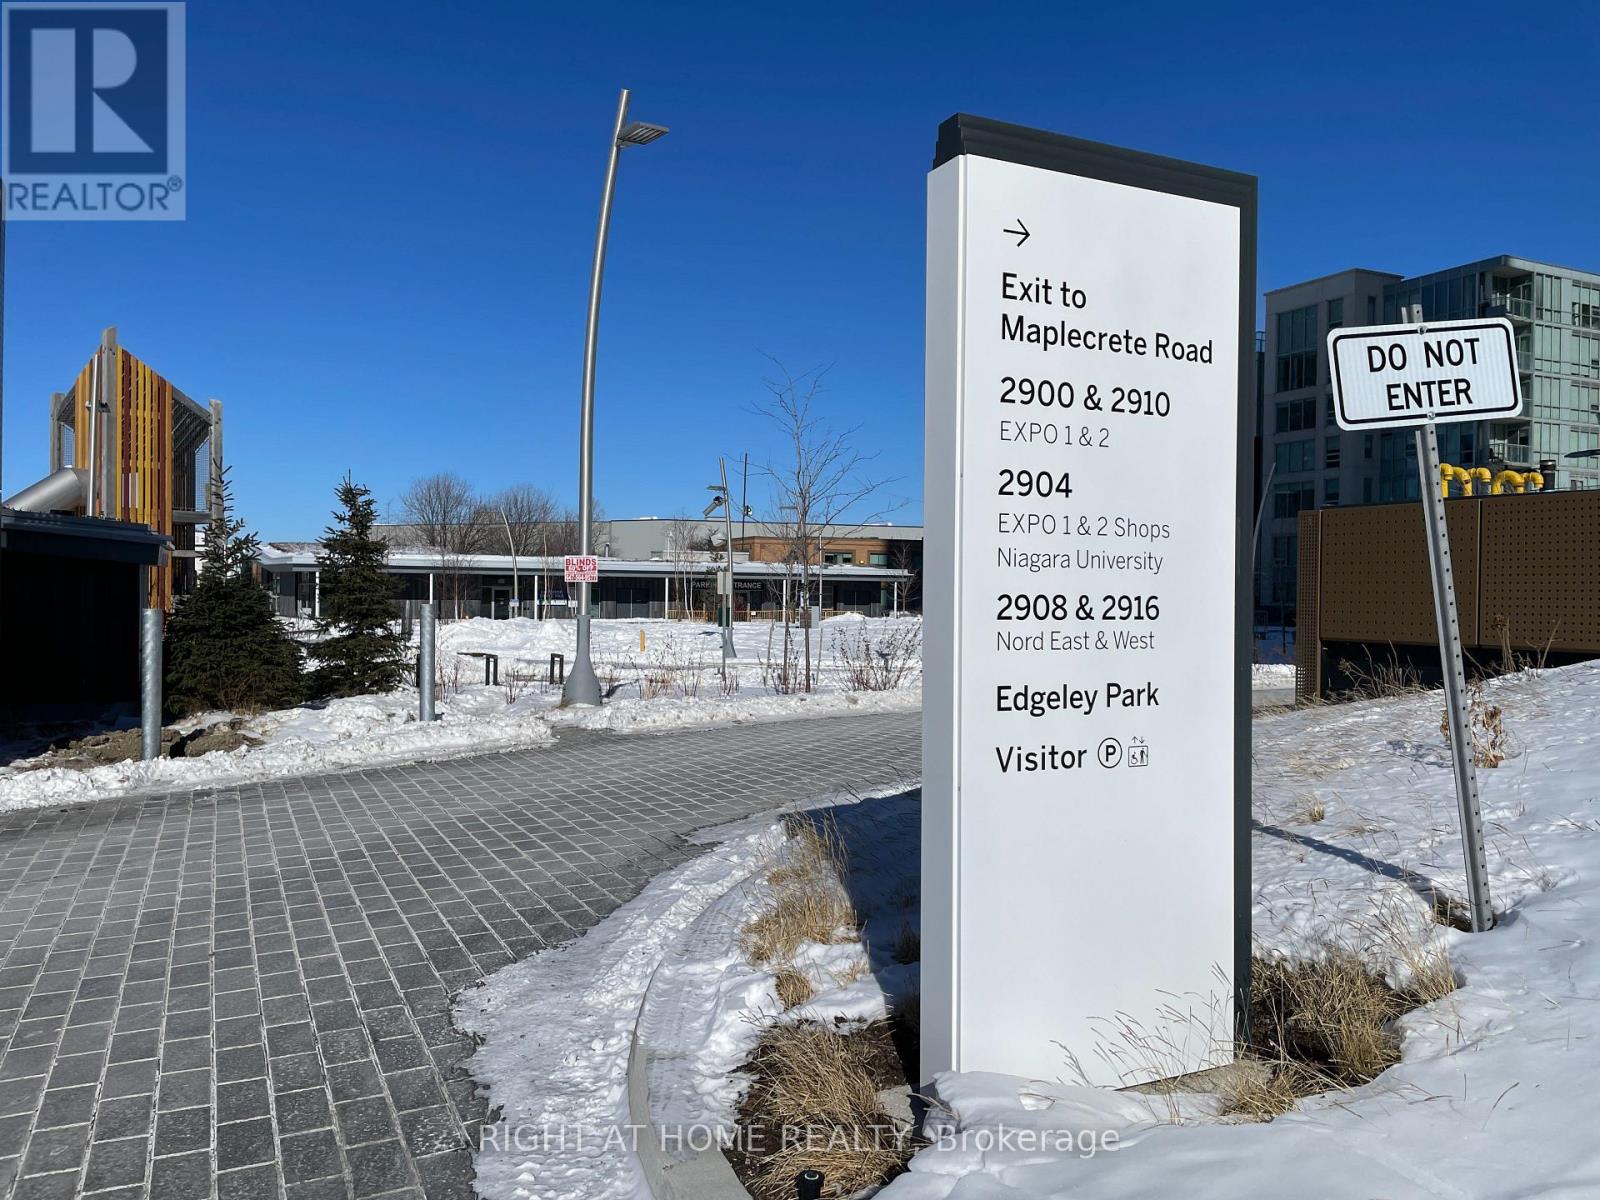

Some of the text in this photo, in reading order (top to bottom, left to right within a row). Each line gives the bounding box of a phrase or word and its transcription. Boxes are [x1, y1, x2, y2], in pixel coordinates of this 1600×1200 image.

[1002, 271, 1087, 309] Exit to
[1001, 312, 1213, 365] Maplecrete Road
[1366, 337, 1480, 373] DO NOT
[999, 376, 1171, 418] 2900 & 2910
[1386, 378, 1473, 411] ENTER
[1000, 420, 1110, 448] EXPO 1 & 2
[997, 468, 1073, 499] 2904
[998, 512, 1170, 543] EXPO 1 & 2 Shops
[565, 558, 597, 566] BLINDS
[997, 547, 1163, 575] Niagara University
[996, 593, 1160, 621] 2908 & 2916
[997, 630, 1155, 652] Nord East & West
[996, 681, 1160, 718] Edgeley Park
[995, 744, 1088, 773] Visitor
